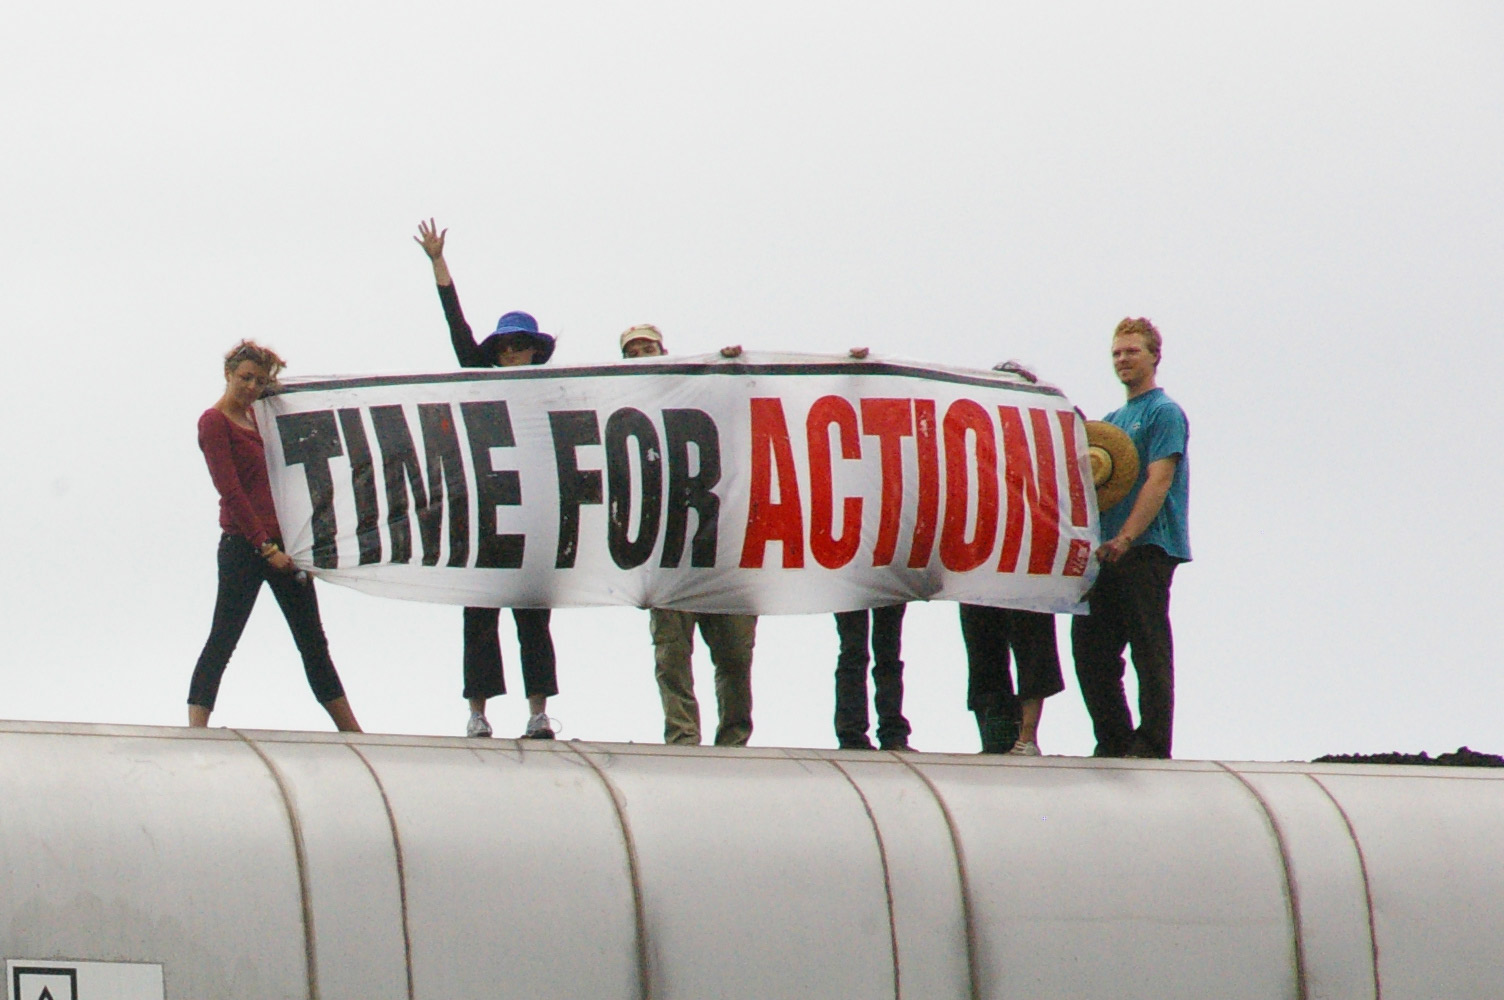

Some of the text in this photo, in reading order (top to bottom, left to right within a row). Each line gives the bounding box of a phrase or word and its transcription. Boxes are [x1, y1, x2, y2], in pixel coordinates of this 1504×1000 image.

[276, 394, 1091, 577] TIME FOR ACTION!
